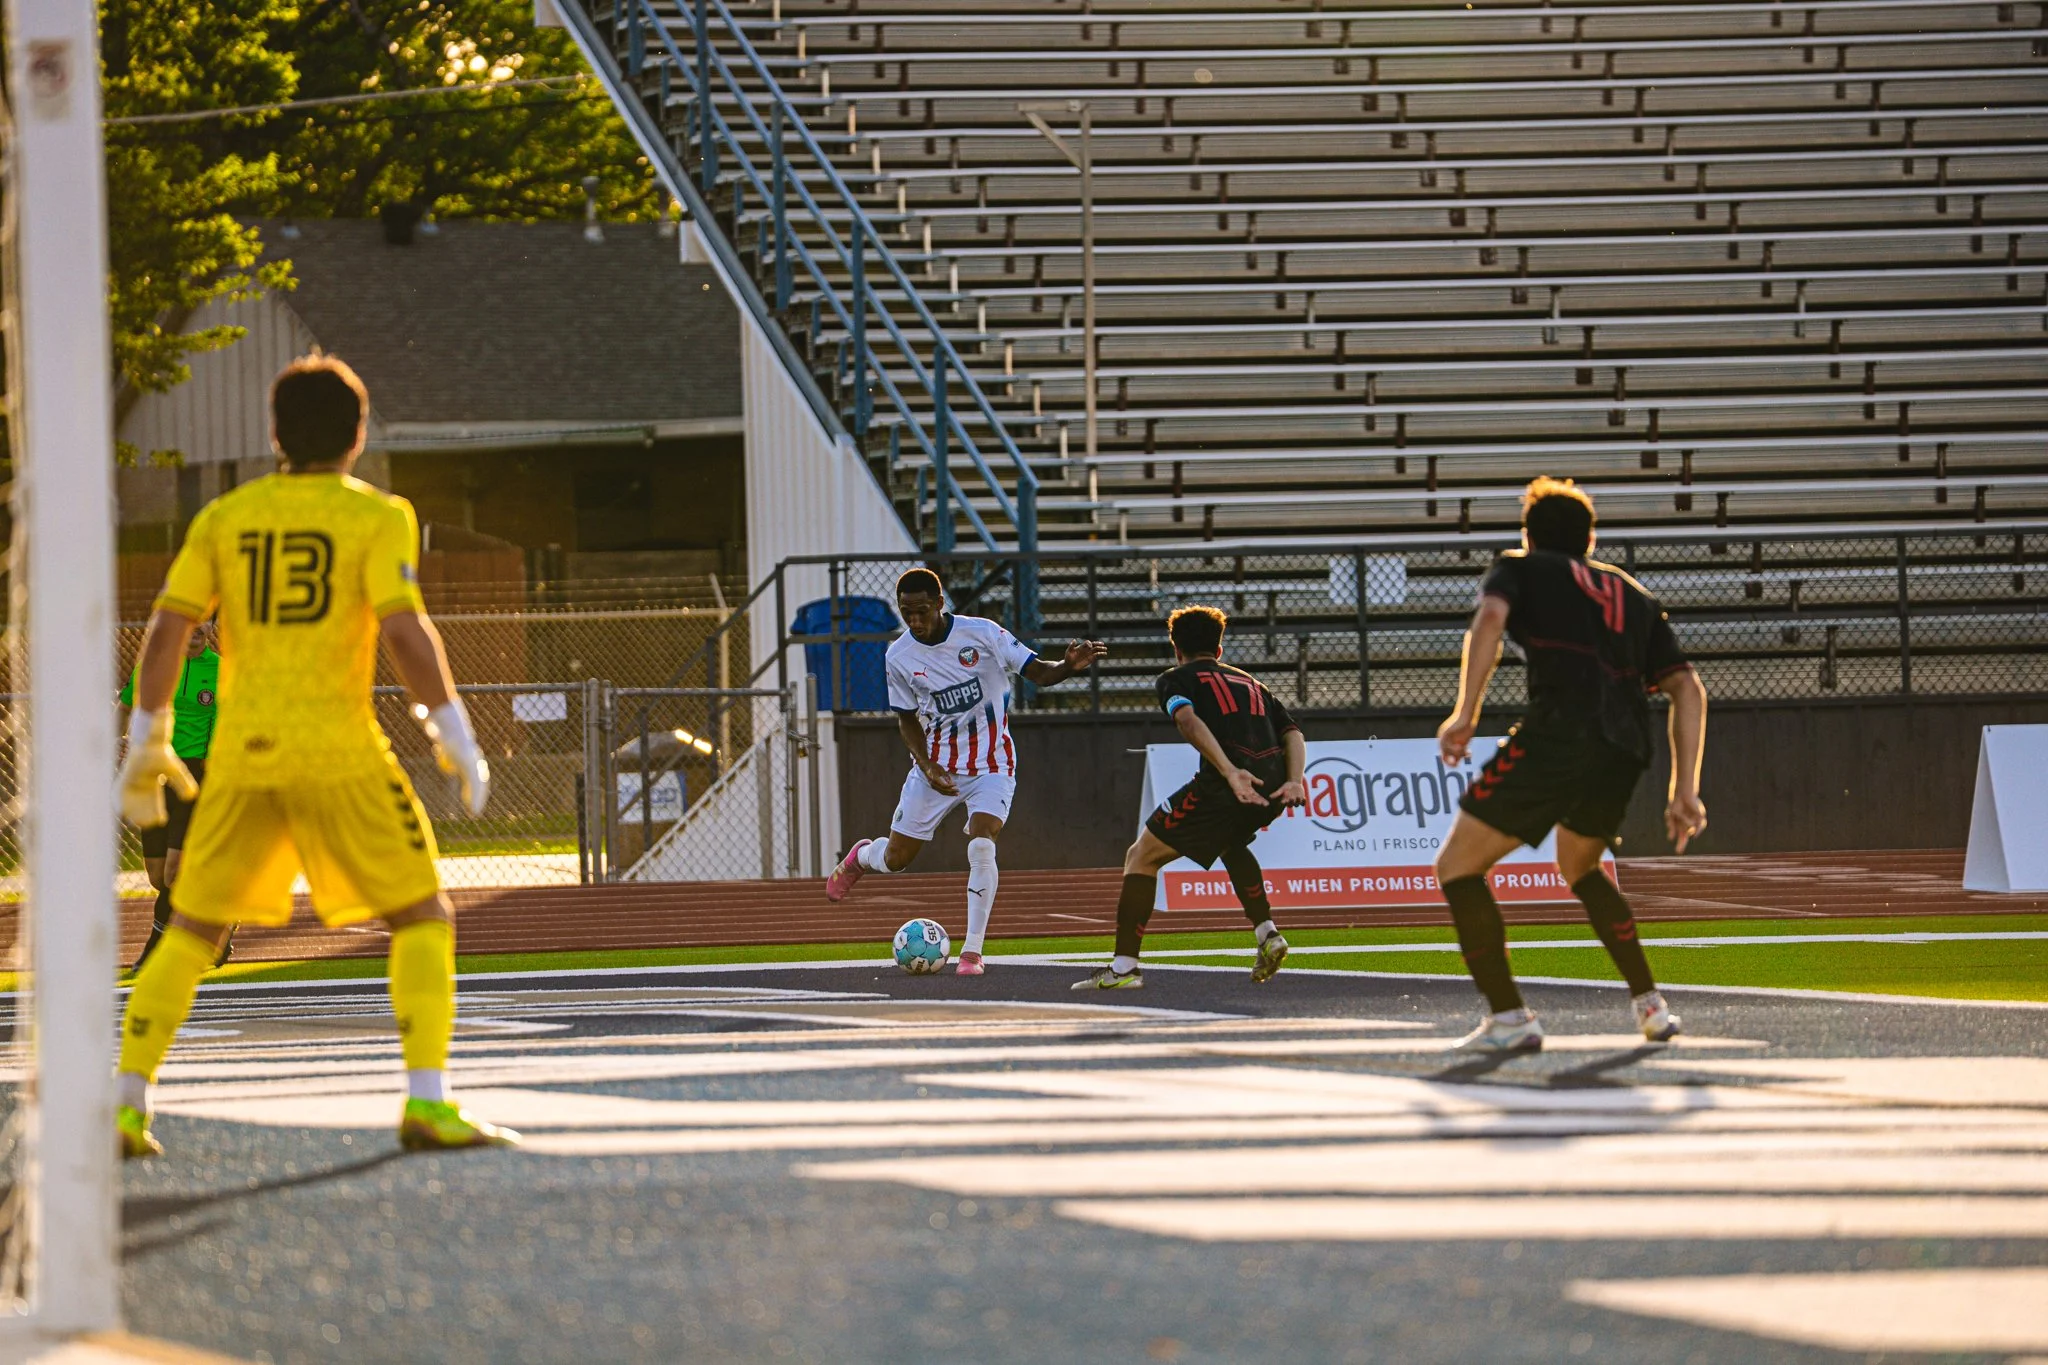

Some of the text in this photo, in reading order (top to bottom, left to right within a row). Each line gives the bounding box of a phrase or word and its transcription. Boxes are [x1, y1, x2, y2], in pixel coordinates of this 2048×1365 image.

[238, 530, 335, 625] 13
[934, 680, 982, 711] TUPPS
[1196, 671, 1265, 716] 17
[1313, 837, 1440, 851] PLANO FRISCO
[1181, 873, 1568, 896] PRINTG. WHEN PROMISE PROMIS
